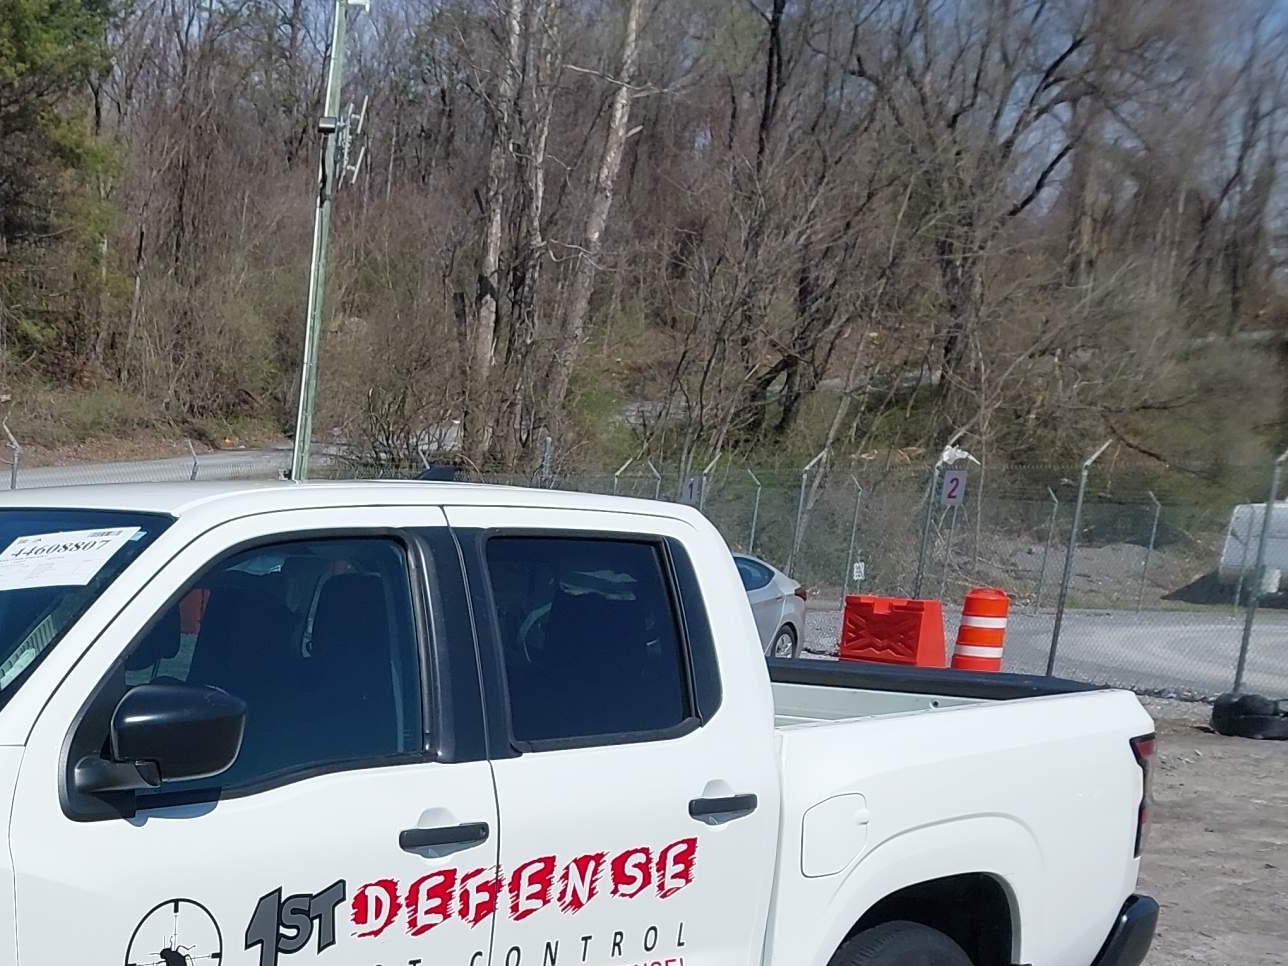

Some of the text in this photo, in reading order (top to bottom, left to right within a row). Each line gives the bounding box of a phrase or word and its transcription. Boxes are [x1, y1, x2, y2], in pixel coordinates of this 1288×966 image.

[947, 477, 960, 499] 2
[12, 540, 111, 557] 44608807
[350, 837, 698, 938] DEFENSE
